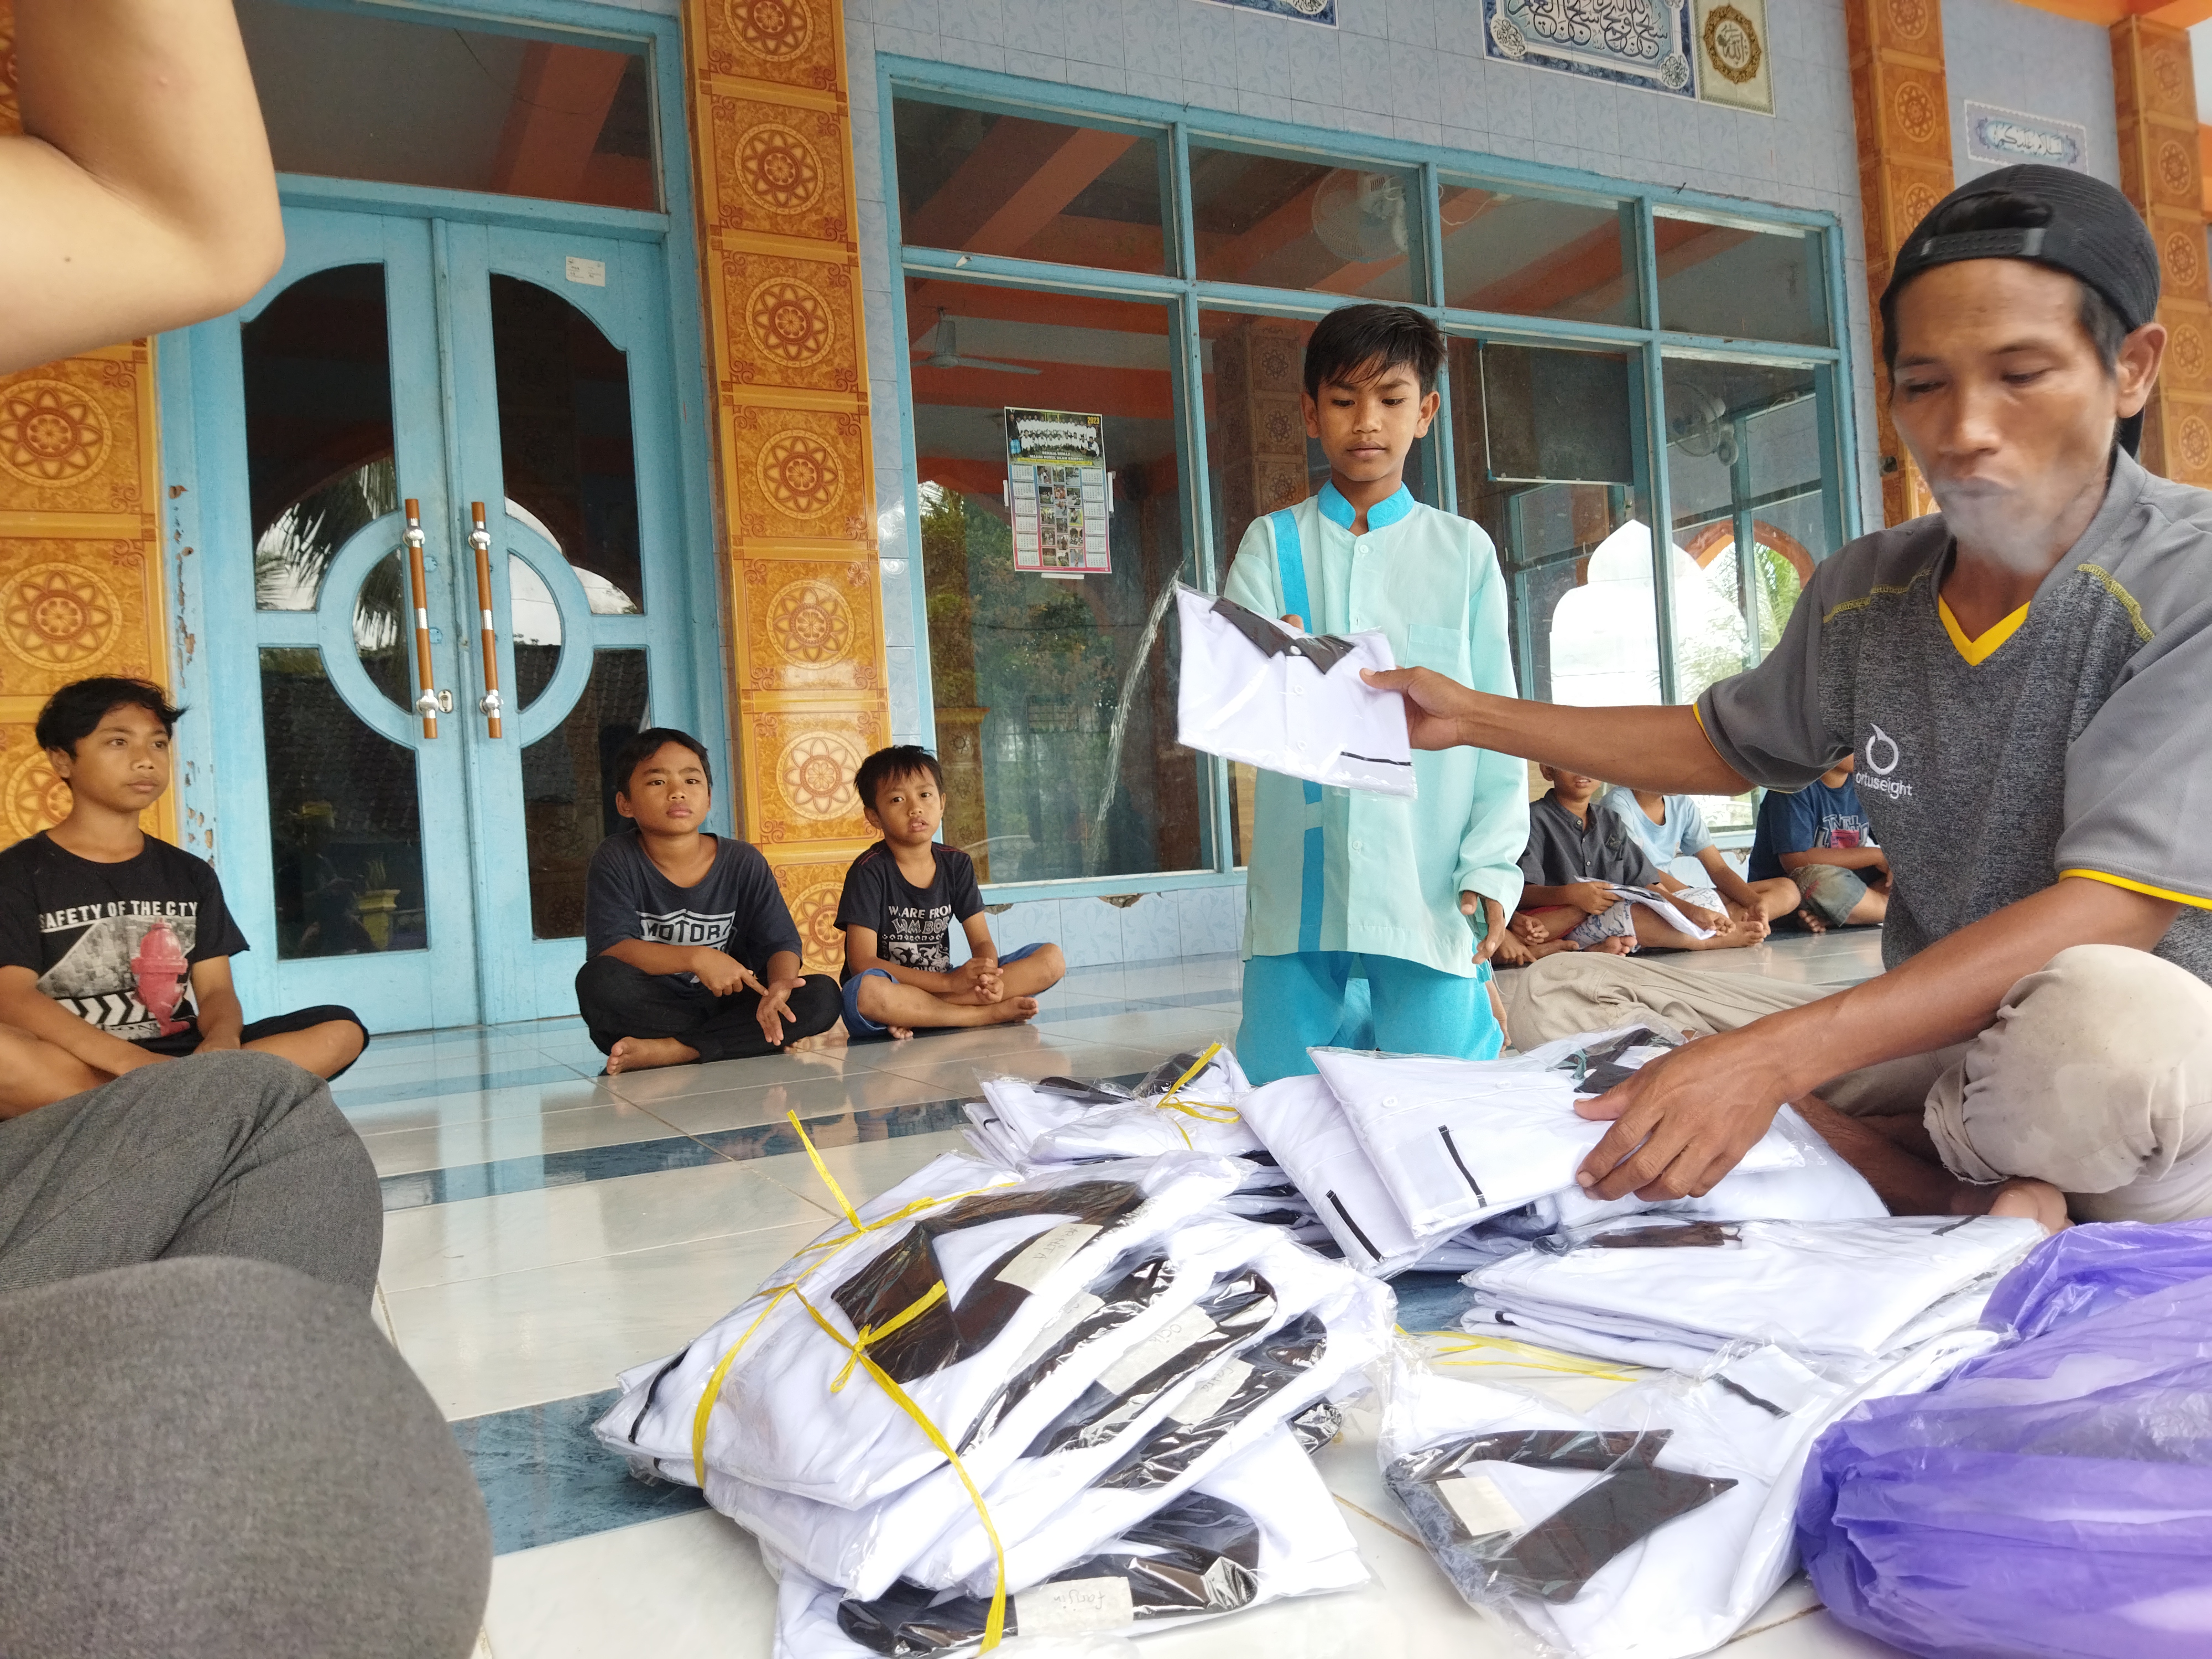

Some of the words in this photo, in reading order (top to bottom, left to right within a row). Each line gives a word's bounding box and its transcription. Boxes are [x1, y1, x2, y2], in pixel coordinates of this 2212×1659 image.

[1855, 772, 1913, 799] ortuseight
[107, 901, 126, 917] OF
[130, 900, 161, 916] THE
[901, 907, 926, 919] ARE
[647, 919, 721, 943] MOTOR
